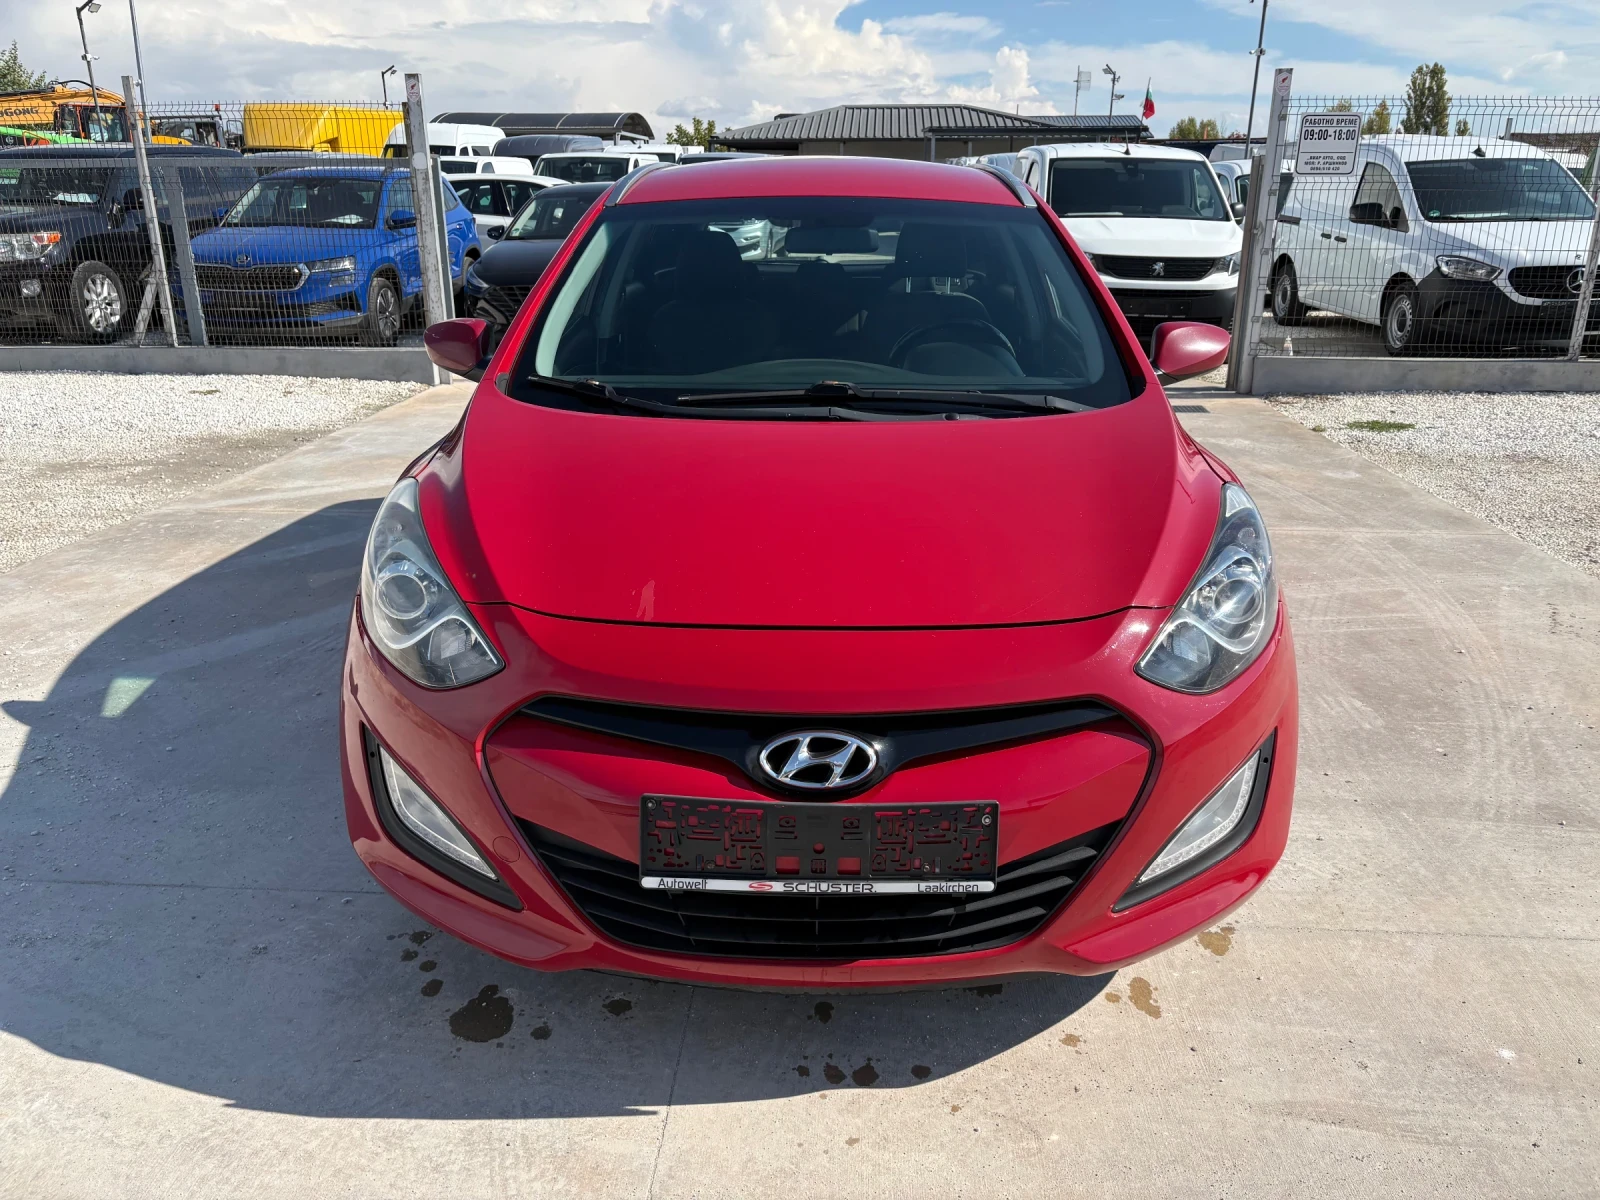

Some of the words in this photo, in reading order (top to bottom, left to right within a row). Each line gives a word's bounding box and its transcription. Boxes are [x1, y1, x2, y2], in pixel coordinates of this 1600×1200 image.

[1304, 118, 1335, 126] РАБОТНО
[1336, 118, 1358, 126] ВРЕМЕ
[1303, 129, 1356, 141] 09:00-18:00
[917, 883, 979, 893] Laakirchen
